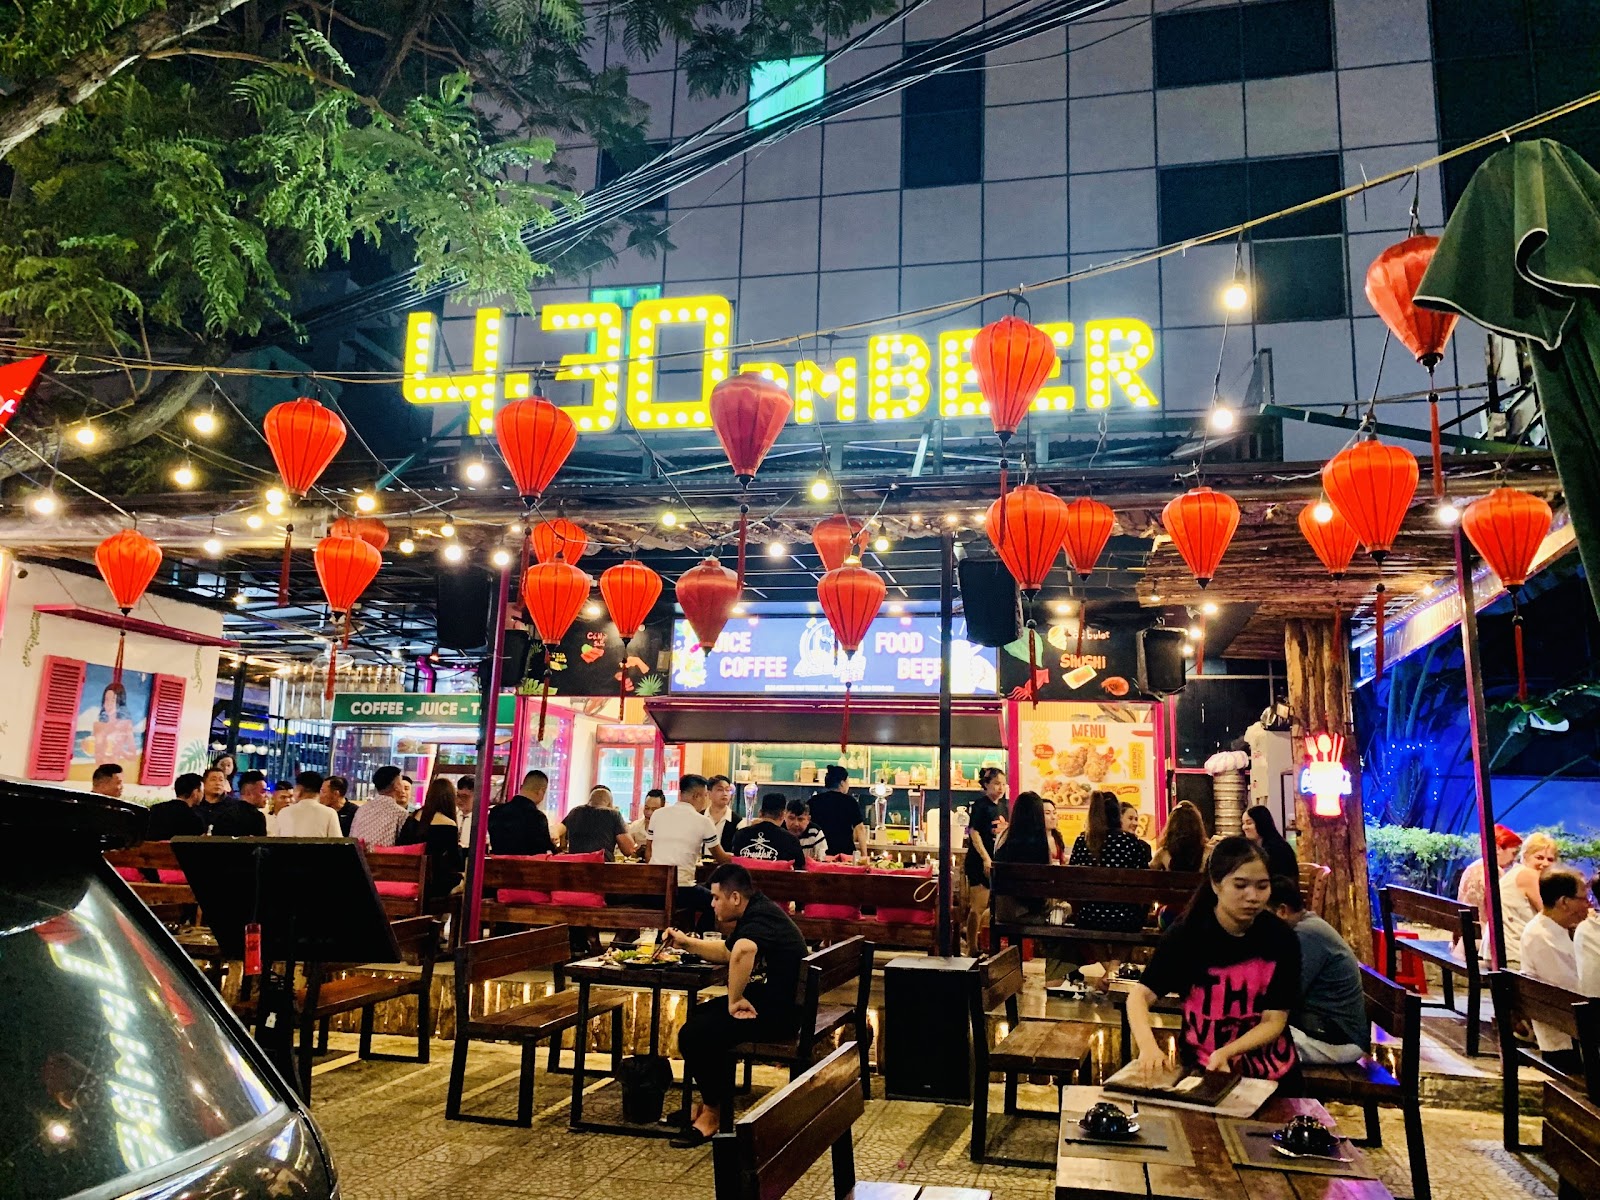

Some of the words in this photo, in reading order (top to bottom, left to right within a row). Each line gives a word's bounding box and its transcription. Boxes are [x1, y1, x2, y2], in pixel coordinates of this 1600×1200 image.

[875, 631, 924, 654] FOOD
[719, 656, 788, 679] COFFEE
[350, 701, 404, 716] COFFEE
[416, 701, 459, 716] JUICE
[1071, 724, 1106, 738] MENU
